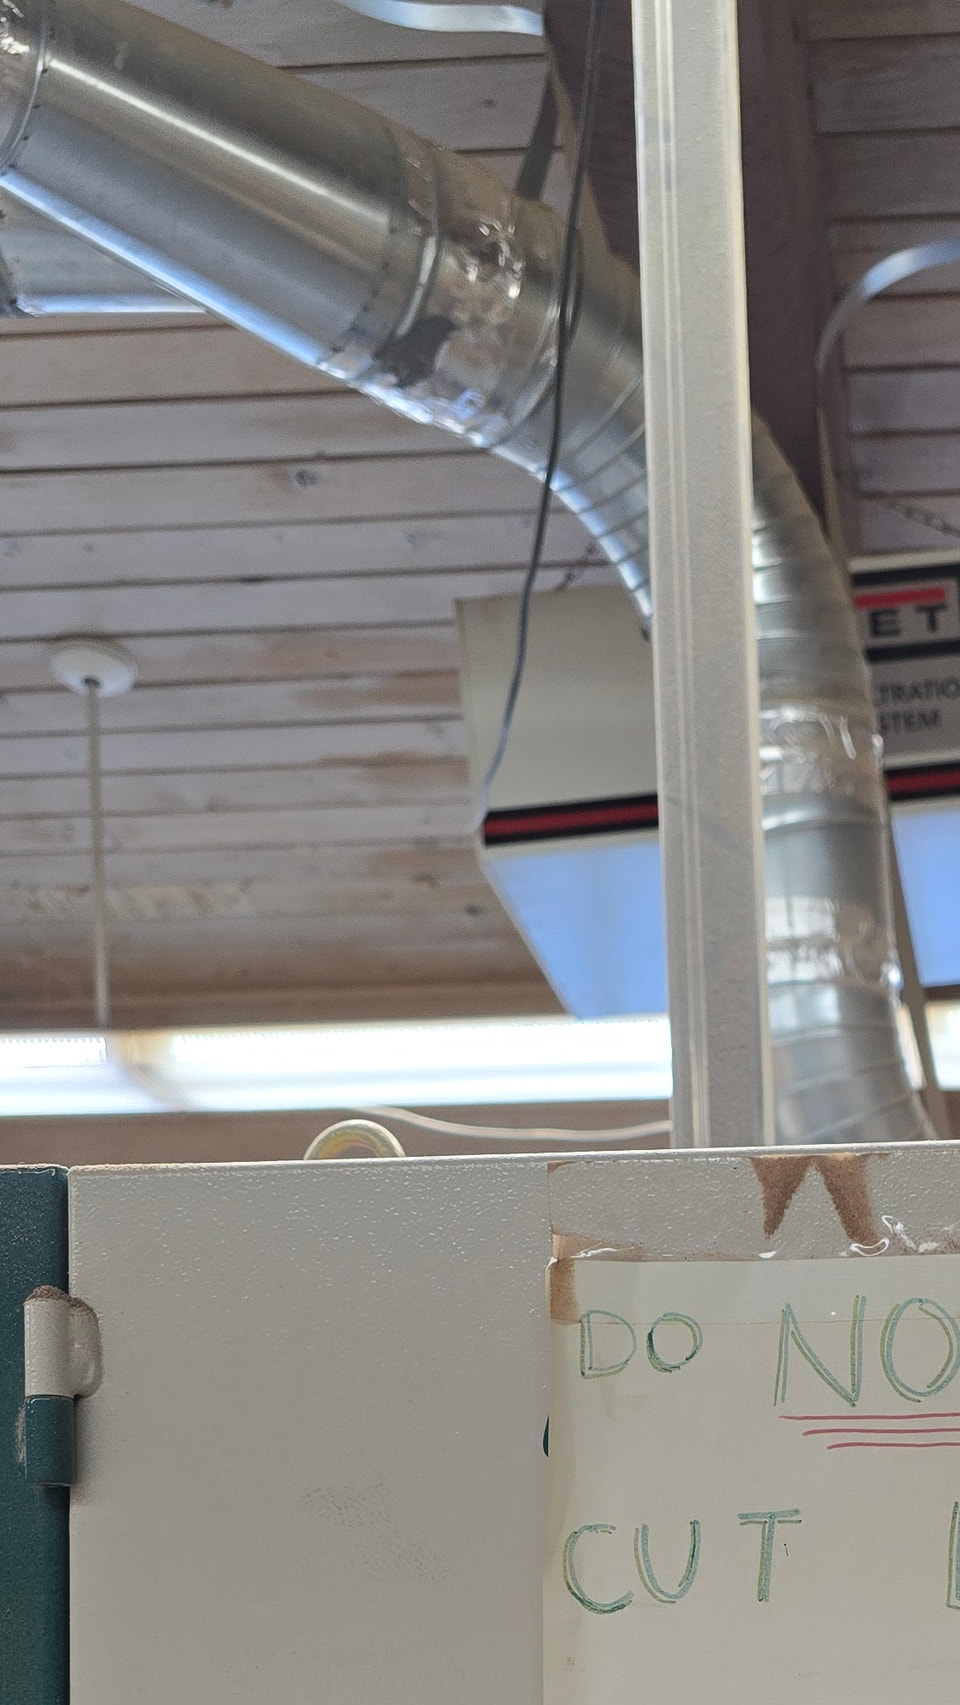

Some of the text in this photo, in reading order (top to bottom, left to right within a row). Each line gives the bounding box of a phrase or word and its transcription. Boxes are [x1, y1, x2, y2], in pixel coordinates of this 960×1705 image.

[870, 603, 947, 638] ET
[580, 1309, 702, 1379] DO
[562, 1508, 802, 1614] CUT
